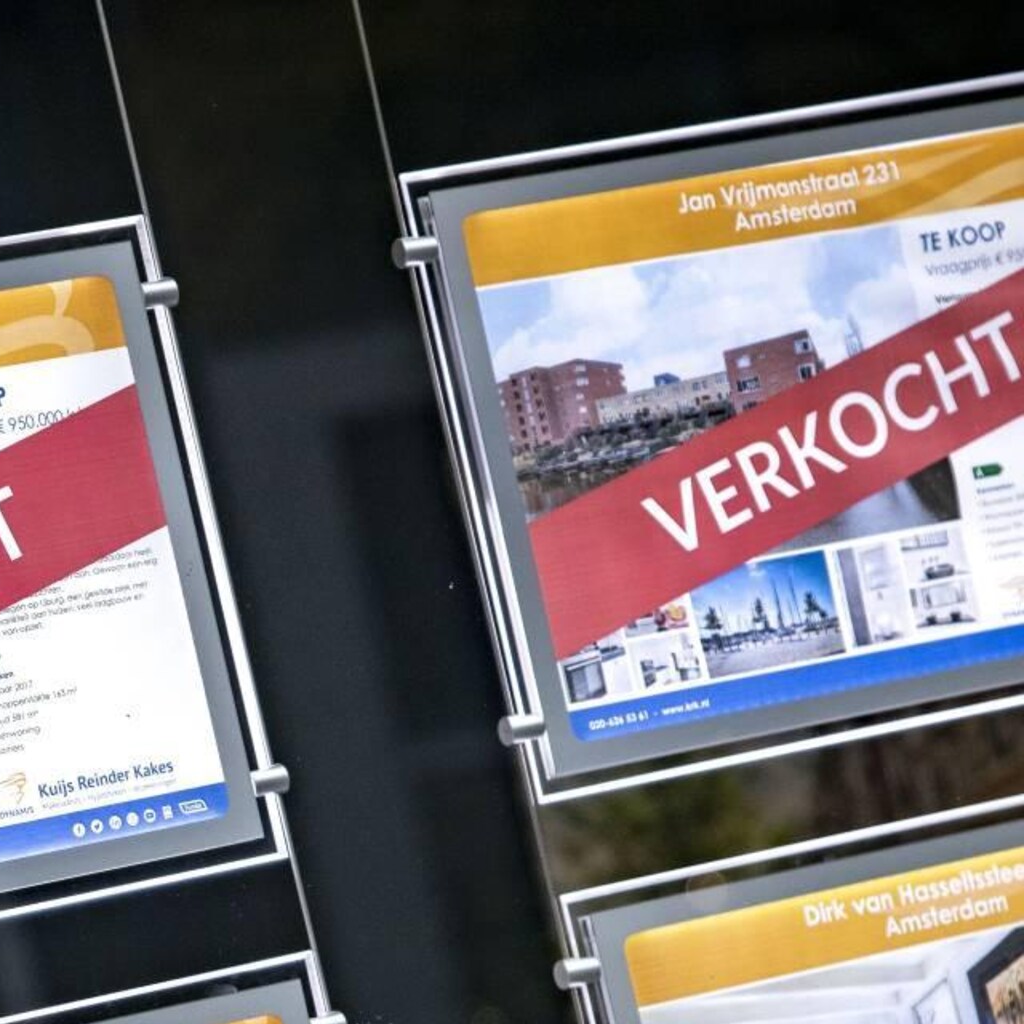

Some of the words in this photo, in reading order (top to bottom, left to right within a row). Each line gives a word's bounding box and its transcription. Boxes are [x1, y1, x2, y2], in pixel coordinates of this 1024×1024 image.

[678, 191, 716, 214] Jan
[720, 165, 860, 207] Vrijmanstraat
[863, 161, 901, 186] 231
[735, 197, 857, 232] Amsterdam
[919, 231, 942, 253] TE
[947, 220, 1006, 248] KOOP
[924, 254, 992, 276] Vraagprijs
[640, 310, 1021, 552] VERKOCHT
[38, 780, 75, 799] Kuijs
[77, 769, 130, 791] Reinder
[133, 760, 175, 780] Kakes
[0, 806, 35, 820] DYNAMIS
[803, 900, 849, 927] Dirk
[851, 892, 894, 915] van
[885, 894, 1009, 938] Amsterdam
